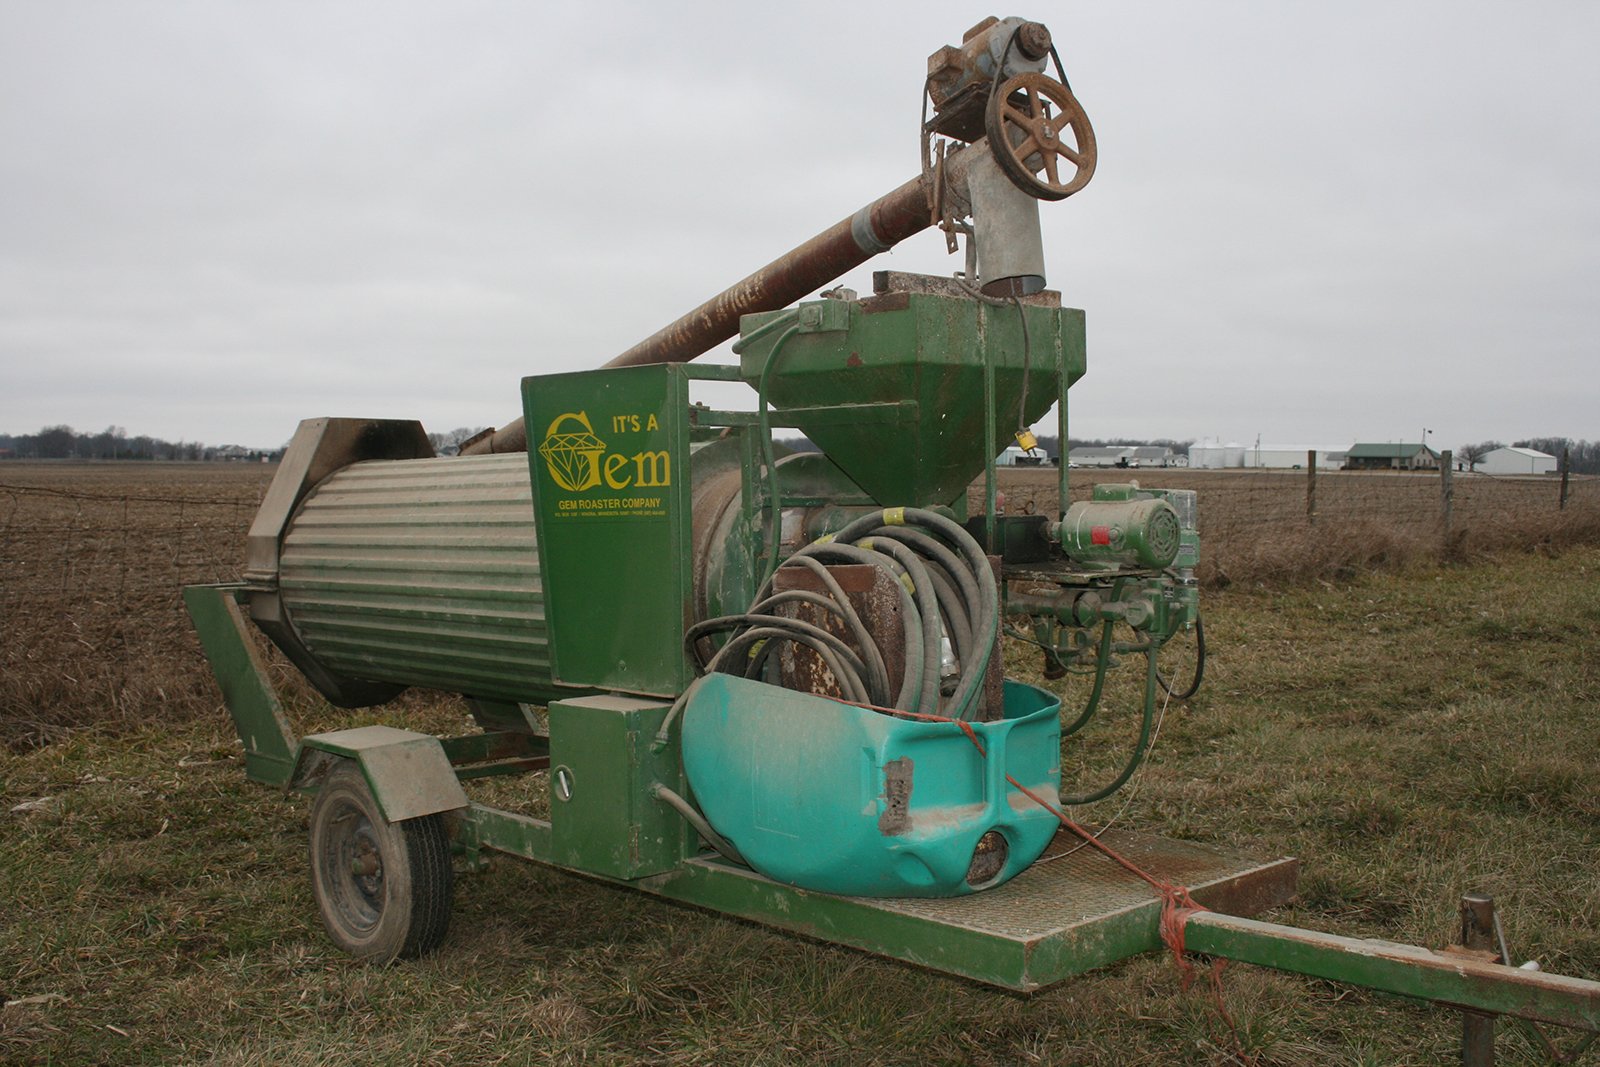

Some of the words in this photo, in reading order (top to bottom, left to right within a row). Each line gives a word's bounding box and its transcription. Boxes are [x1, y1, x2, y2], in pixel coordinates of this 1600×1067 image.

[612, 415, 641, 433] IT'S
[647, 413, 659, 432] A
[540, 410, 671, 492] Gem
[558, 500, 577, 510] GEM
[578, 499, 621, 509] ROASTER
[621, 498, 661, 508] COMPANY
